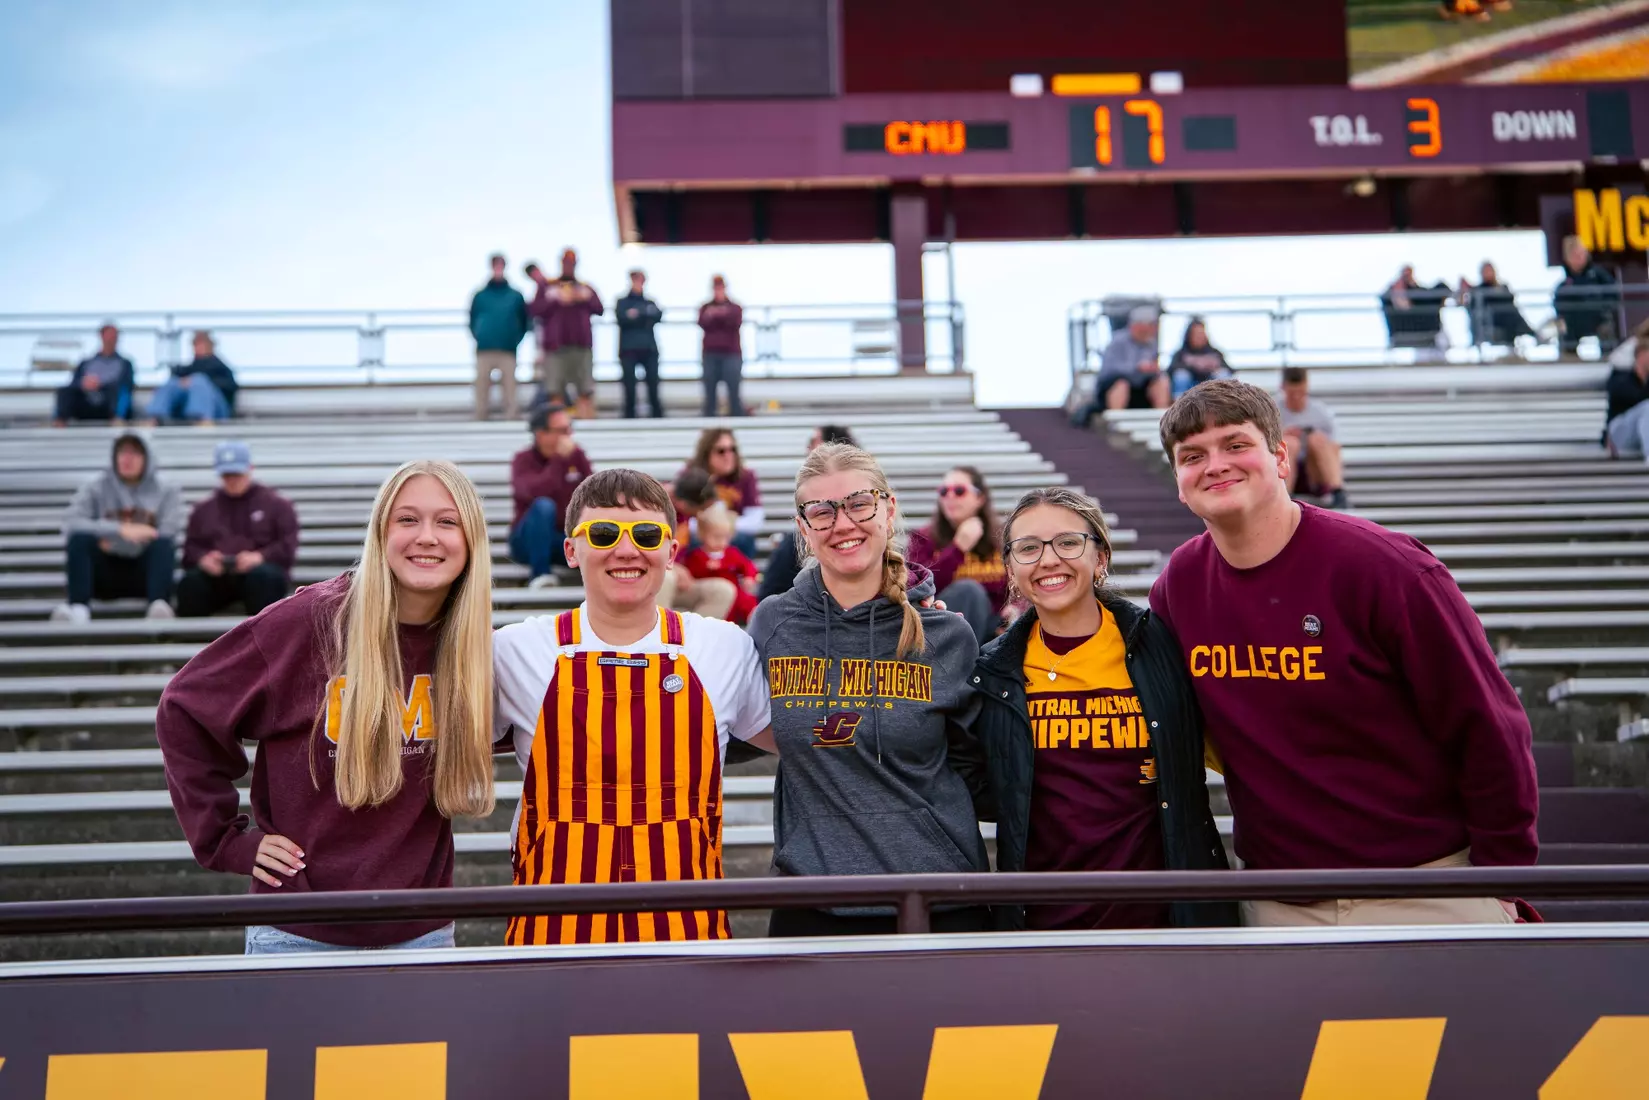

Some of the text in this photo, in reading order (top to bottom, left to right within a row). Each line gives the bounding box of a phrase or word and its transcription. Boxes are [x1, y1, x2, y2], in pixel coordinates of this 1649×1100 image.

[884, 120, 966, 155] CMU
[1094, 99, 1165, 165] 17
[1406, 98, 1442, 157] 3
[1492, 110, 1577, 141] DOWN
[838, 658, 932, 702] MICHIGAN
[1190, 645, 1326, 681] COLLEGE
[1026, 695, 1143, 717] NTRAL MICHIG
